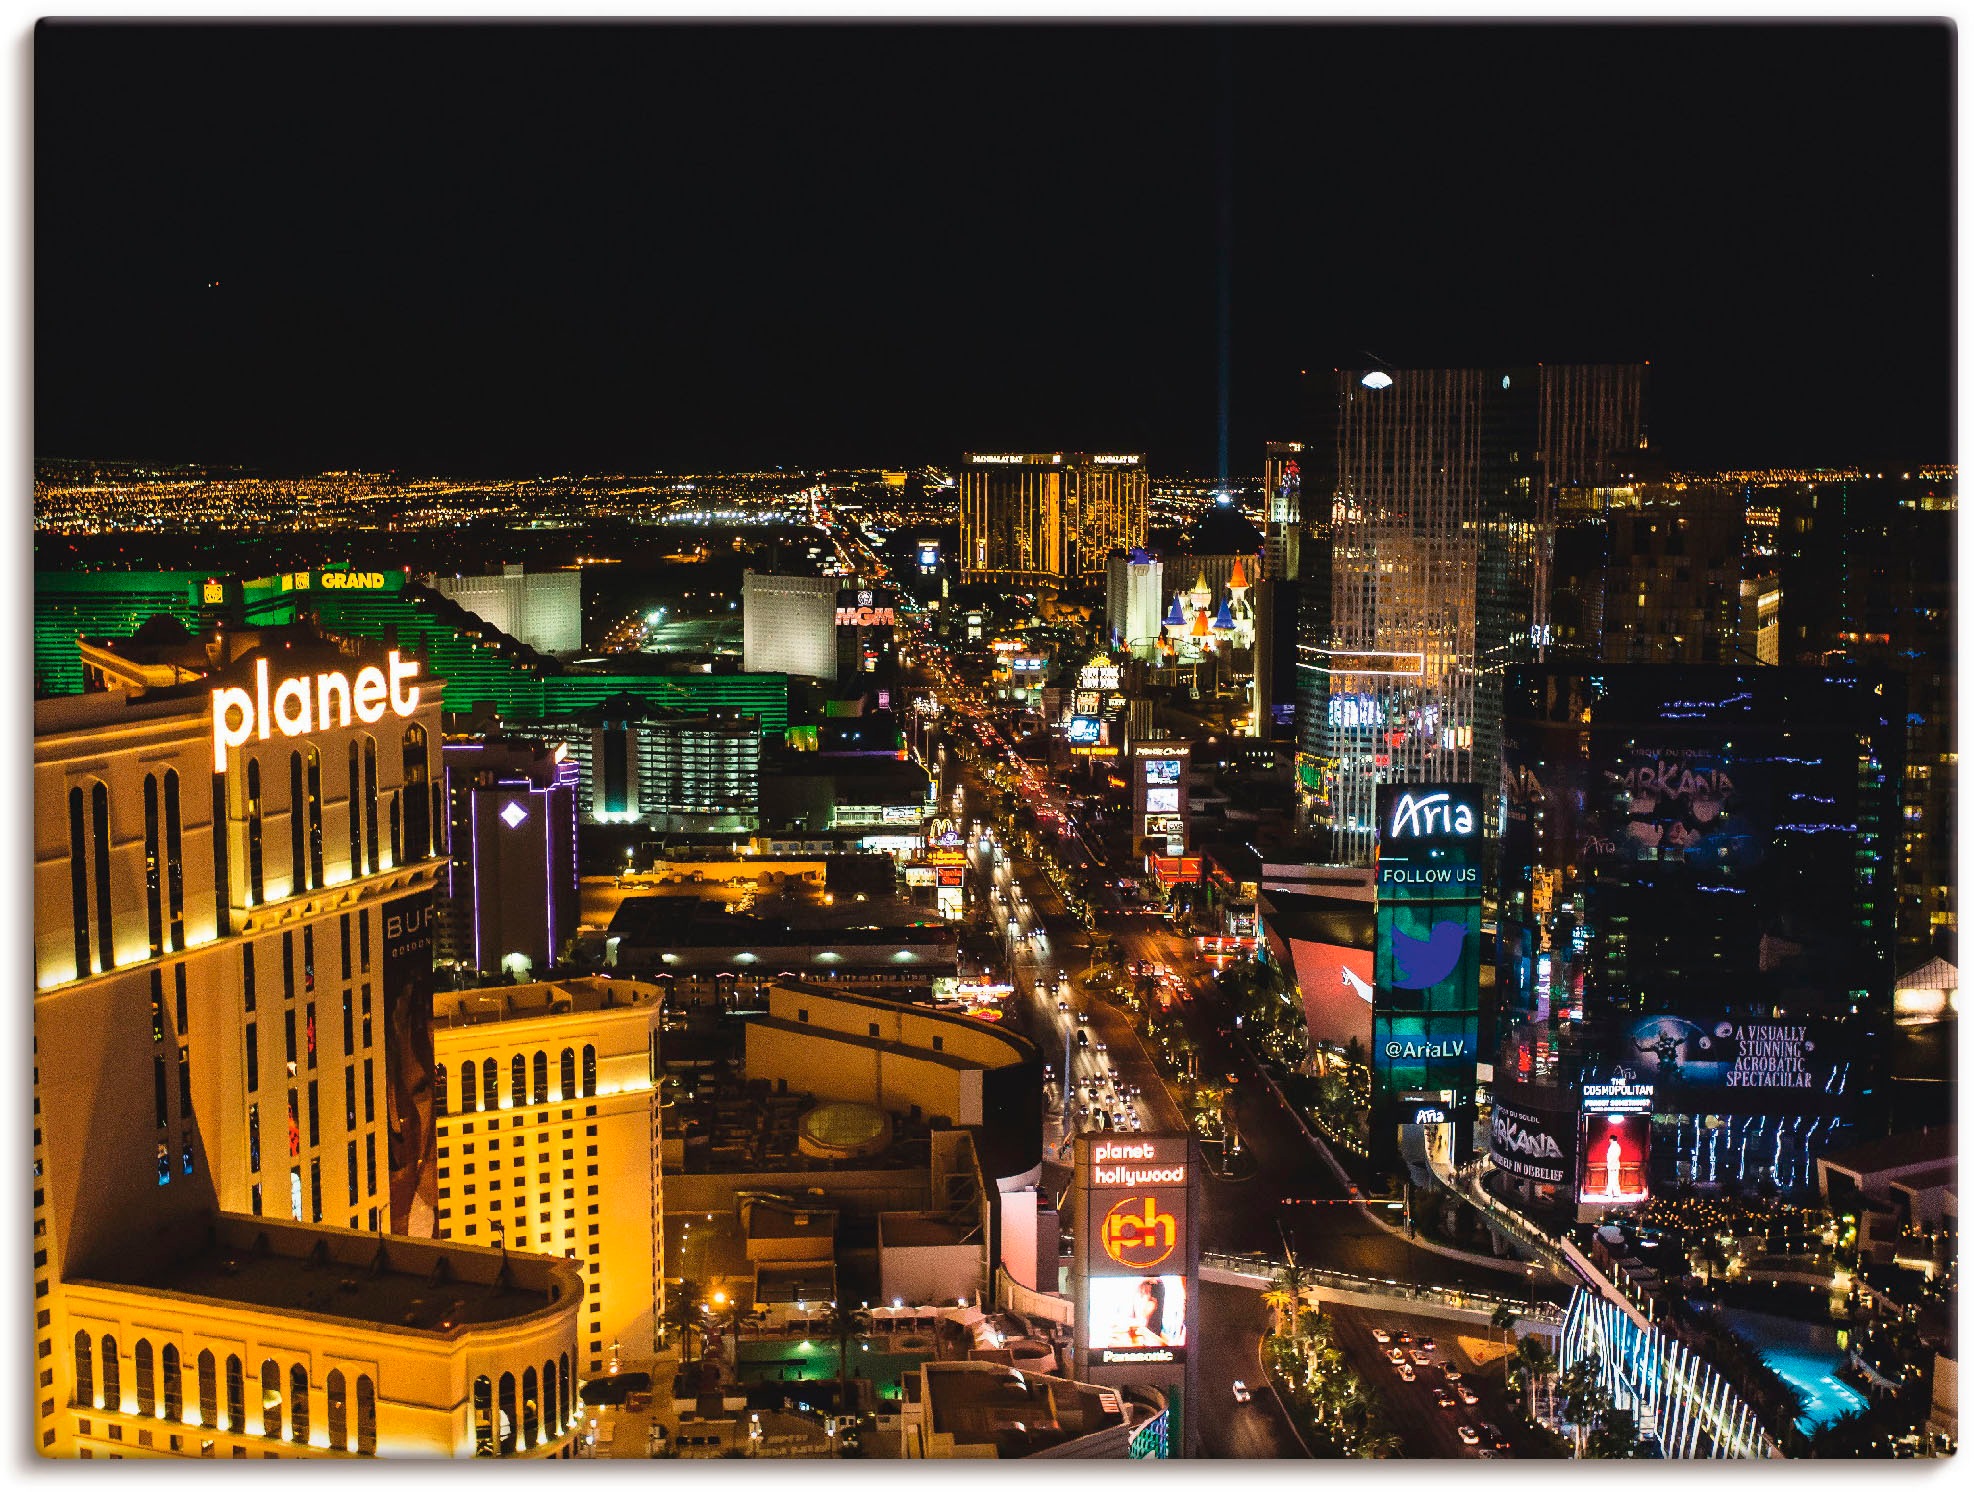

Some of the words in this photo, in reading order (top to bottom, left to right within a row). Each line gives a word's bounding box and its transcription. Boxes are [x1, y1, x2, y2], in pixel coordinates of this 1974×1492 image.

[321, 572, 385, 589] GRAND
[834, 606, 895, 627] MGM
[212, 650, 420, 774] planet
[1390, 793, 1473, 838] Aria
[1383, 869, 1451, 883] FOLLOW
[1456, 868, 1476, 882] US
[1735, 1026, 1745, 1041] A
[1747, 1025, 1808, 1041] VISUALLY
[1739, 1041, 1801, 1057] STUNNING
[1734, 1056, 1806, 1072] ACROBATIC
[1610, 1078, 1626, 1086] THE
[1726, 1071, 1813, 1087] SPECTACULAR
[1583, 1085, 1654, 1096] COSMOPOLITAN
[1416, 1108, 1445, 1124] Aria
[1094, 1143, 1155, 1163] planet
[1094, 1165, 1185, 1188] hollywood
[1513, 1160, 1523, 1173] IN
[1523, 1164, 1564, 1182] DISBELIEF
[1110, 1197, 1176, 1258] ph
[1102, 1350, 1174, 1363] Panasonic
